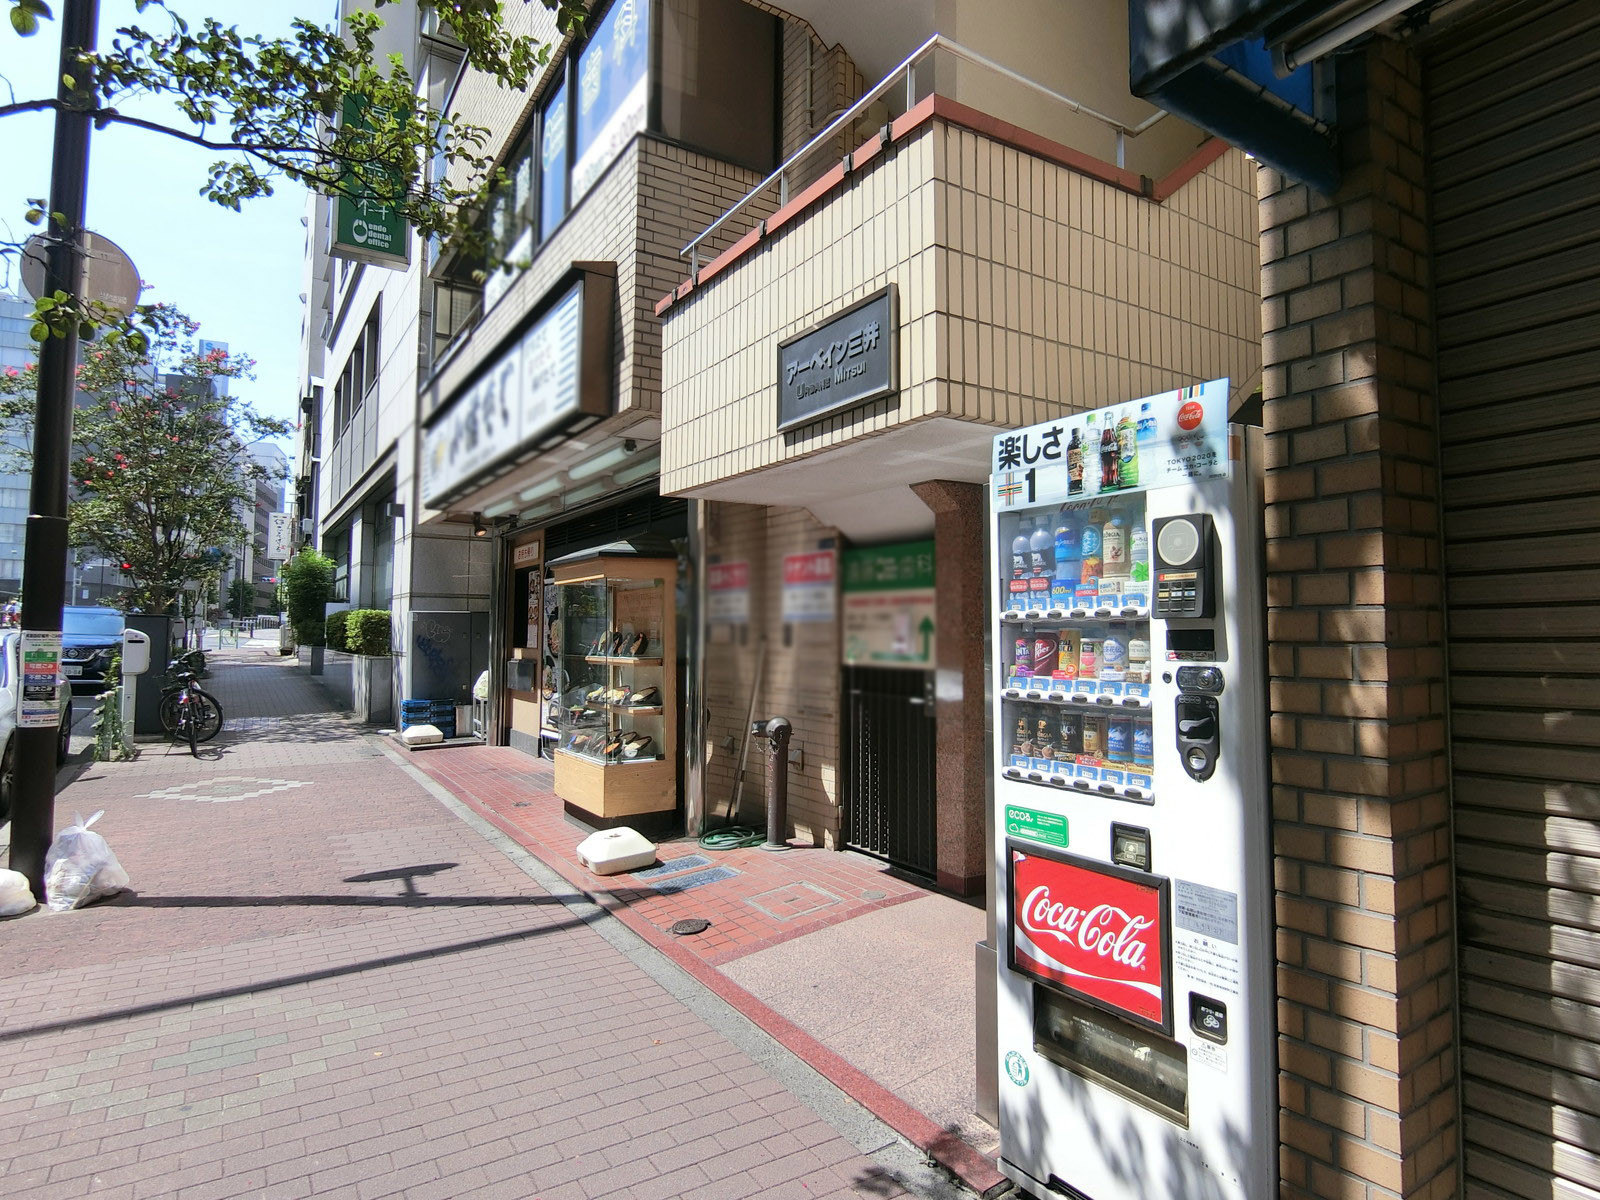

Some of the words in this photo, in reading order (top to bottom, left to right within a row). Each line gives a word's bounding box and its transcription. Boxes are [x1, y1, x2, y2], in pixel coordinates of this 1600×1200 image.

[368, 223, 387, 233] endo
[368, 230, 392, 241] dental
[368, 238, 389, 248] office
[786, 321, 880, 386] アーベイン三井
[999, 426, 1064, 471] 楽しさ
[1025, 468, 1036, 503] 1
[1021, 885, 1155, 970] Coca-Cola
